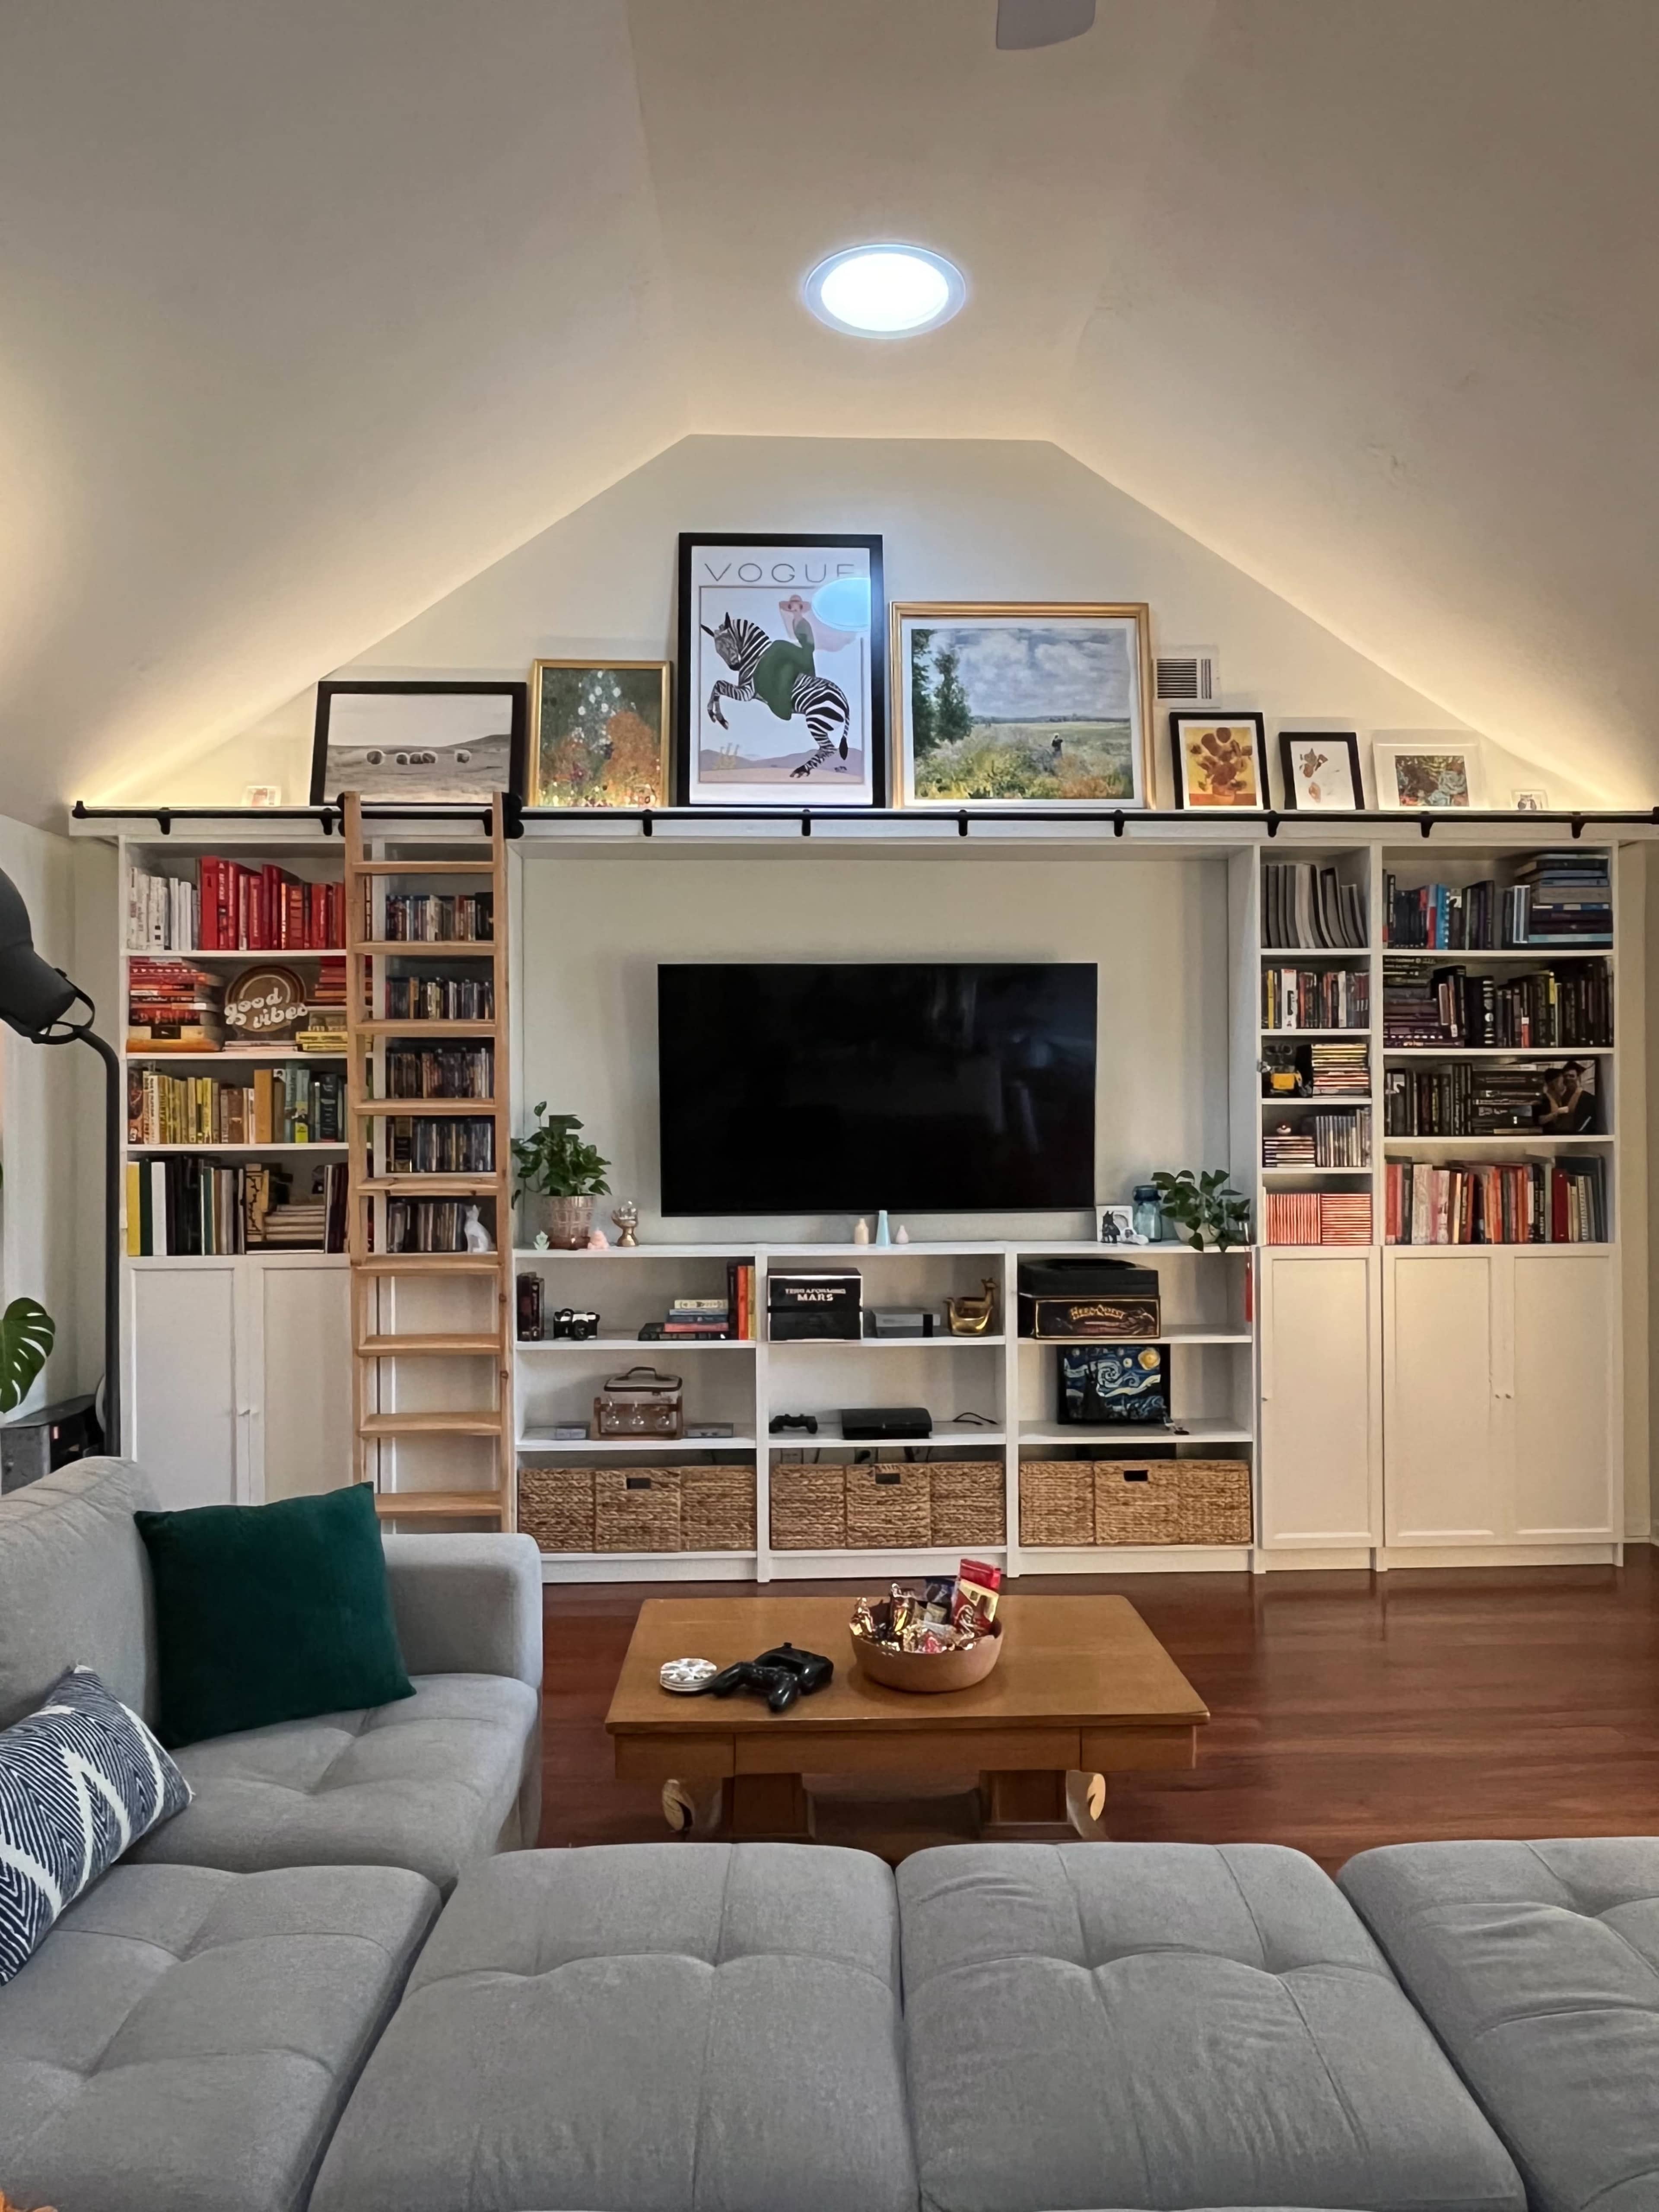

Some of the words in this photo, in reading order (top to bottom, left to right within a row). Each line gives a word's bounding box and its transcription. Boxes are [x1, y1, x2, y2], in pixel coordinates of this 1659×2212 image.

[704, 563, 855, 583] VOGUE
[224, 987, 283, 1026] good
[253, 1003, 308, 1028] vibes
